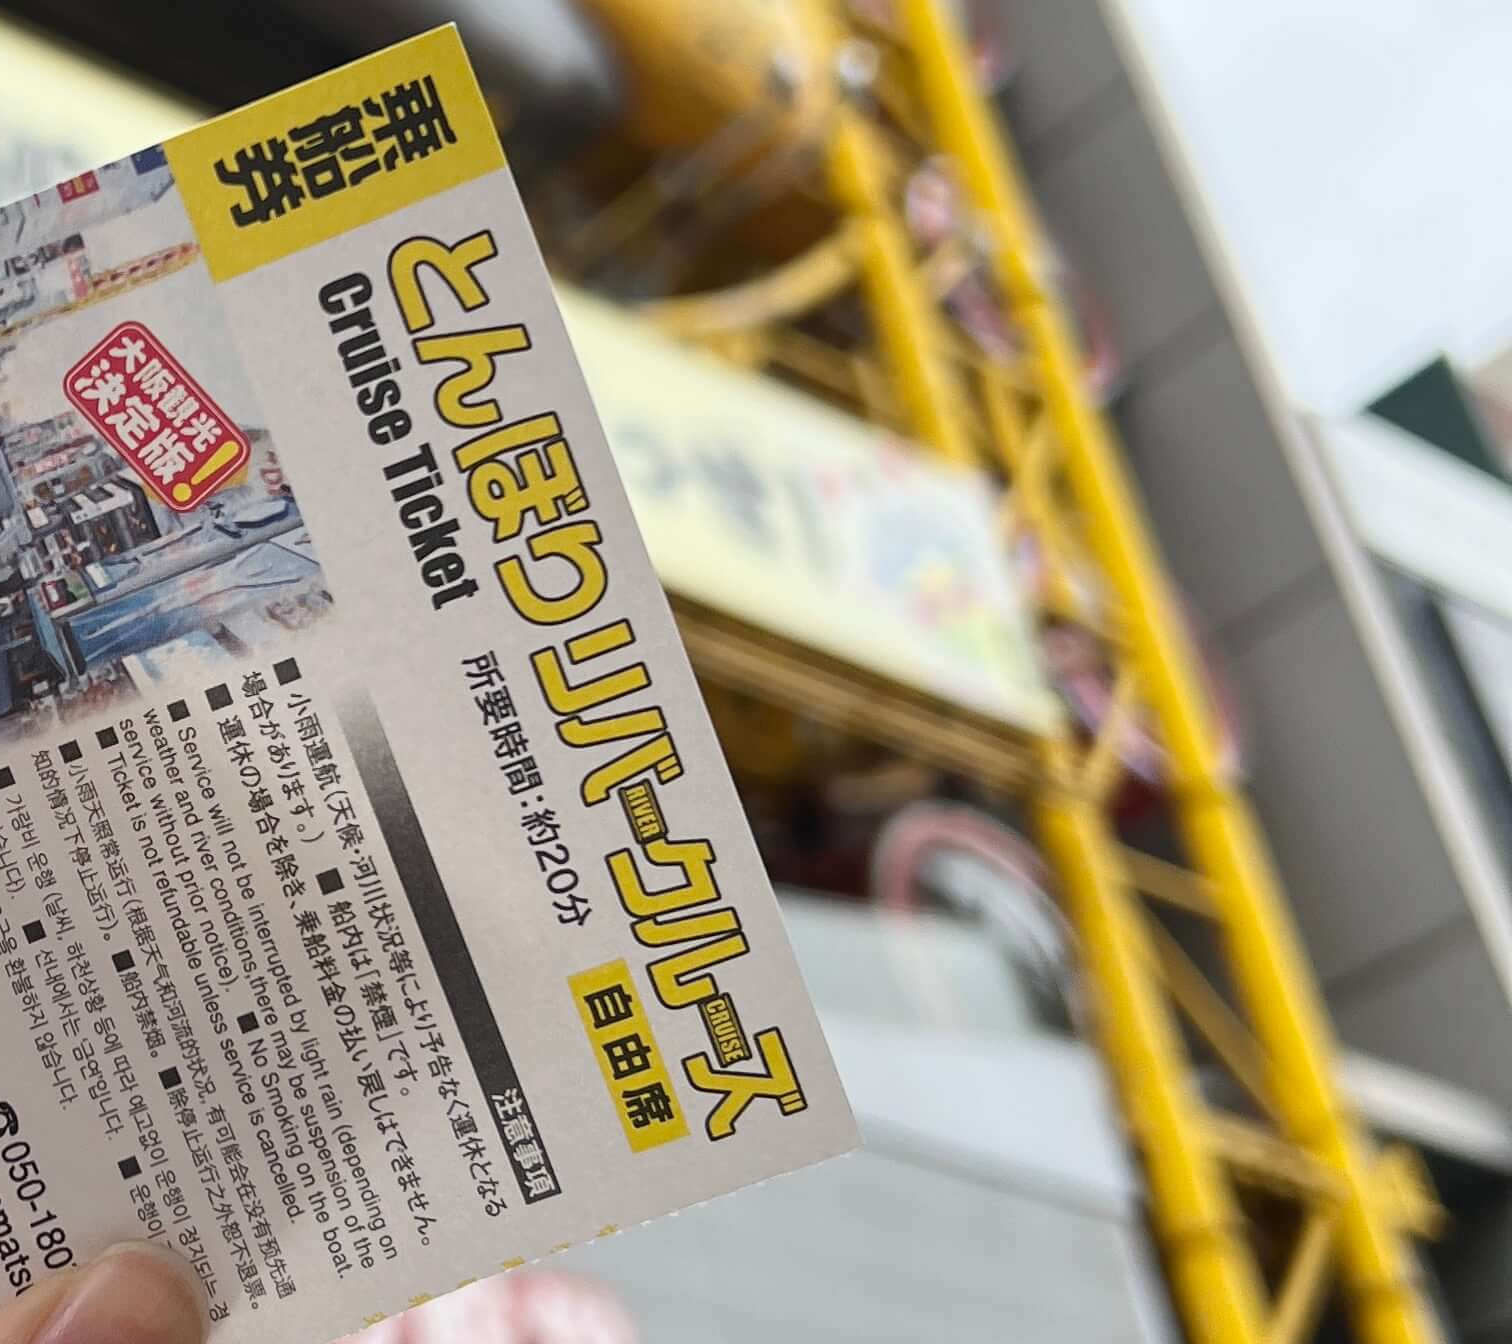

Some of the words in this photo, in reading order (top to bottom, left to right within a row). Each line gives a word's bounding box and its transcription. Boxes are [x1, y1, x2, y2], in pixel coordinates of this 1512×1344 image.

[213, 74, 457, 227] 乗船券
[104, 336, 222, 457] 大阪観光
[318, 271, 412, 445] Cruise
[382, 441, 479, 610] Ticket
[142, 707, 184, 784] weather
[177, 726, 215, 800] Service
[107, 750, 141, 812] Ticket
[174, 789, 203, 826] and
[623, 784, 664, 837] RIVER
[130, 812, 146, 832] is
[138, 834, 164, 867] not
[190, 830, 218, 871] river
[207, 802, 234, 835] will
[221, 839, 247, 872] not
[235, 873, 255, 899] be
[151, 869, 202, 969] refundable
[247, 902, 302, 1007] interrupted
[118, 718, 156, 789] service
[149, 792, 190, 866] without
[174, 869, 208, 913] prior
[199, 919, 239, 992] notice).
[247, 1037, 268, 1067] No
[260, 1071, 304, 1158] Smoking
[295, 1162, 315, 1188] on
[307, 1190, 329, 1223] the
[322, 1226, 352, 1278] boat.
[118, 970, 166, 1058] 船内禁烟。
[193, 972, 228, 1034] unless
[289, 1008, 310, 1033] by
[327, 900, 418, 1096] 船内は「禁煙」です。
[703, 997, 747, 1065] CRUISE
[4, 957, 48, 1030] 환불하지
[33, 1031, 78, 1109] 않습니다.
[5, 793, 40, 849] 가랑비
[25, 851, 57, 890] 운행
[66, 941, 106, 1013] 하천상황
[93, 1016, 123, 1054] 등에
[112, 1054, 138, 1093] 따라
[128, 1094, 168, 1167] 예고없이
[154, 1169, 192, 1224] 운행이
[207, 1301, 230, 1323] 경
[269, 1029, 297, 1069] may
[299, 1037, 329, 1080] light
[582, 983, 674, 1128] 自由席
[34, 949, 80, 1037] 선내에서는
[129, 1183, 166, 1239] 운행이
[219, 1037, 255, 1105] service
[287, 1072, 307, 1100] be
[317, 1083, 342, 1120] rain
[247, 1108, 264, 1126] is
[491, 1087, 555, 1197] 注意事項
[255, 1128, 305, 1223] cancelled.
[299, 1103, 351, 1211] suspension
[331, 1124, 386, 1231] (depending
[0, 1141, 77, 1269] 050-180
[343, 1214, 366, 1233] of
[352, 1236, 374, 1269] the
[368, 1234, 397, 1260] on
